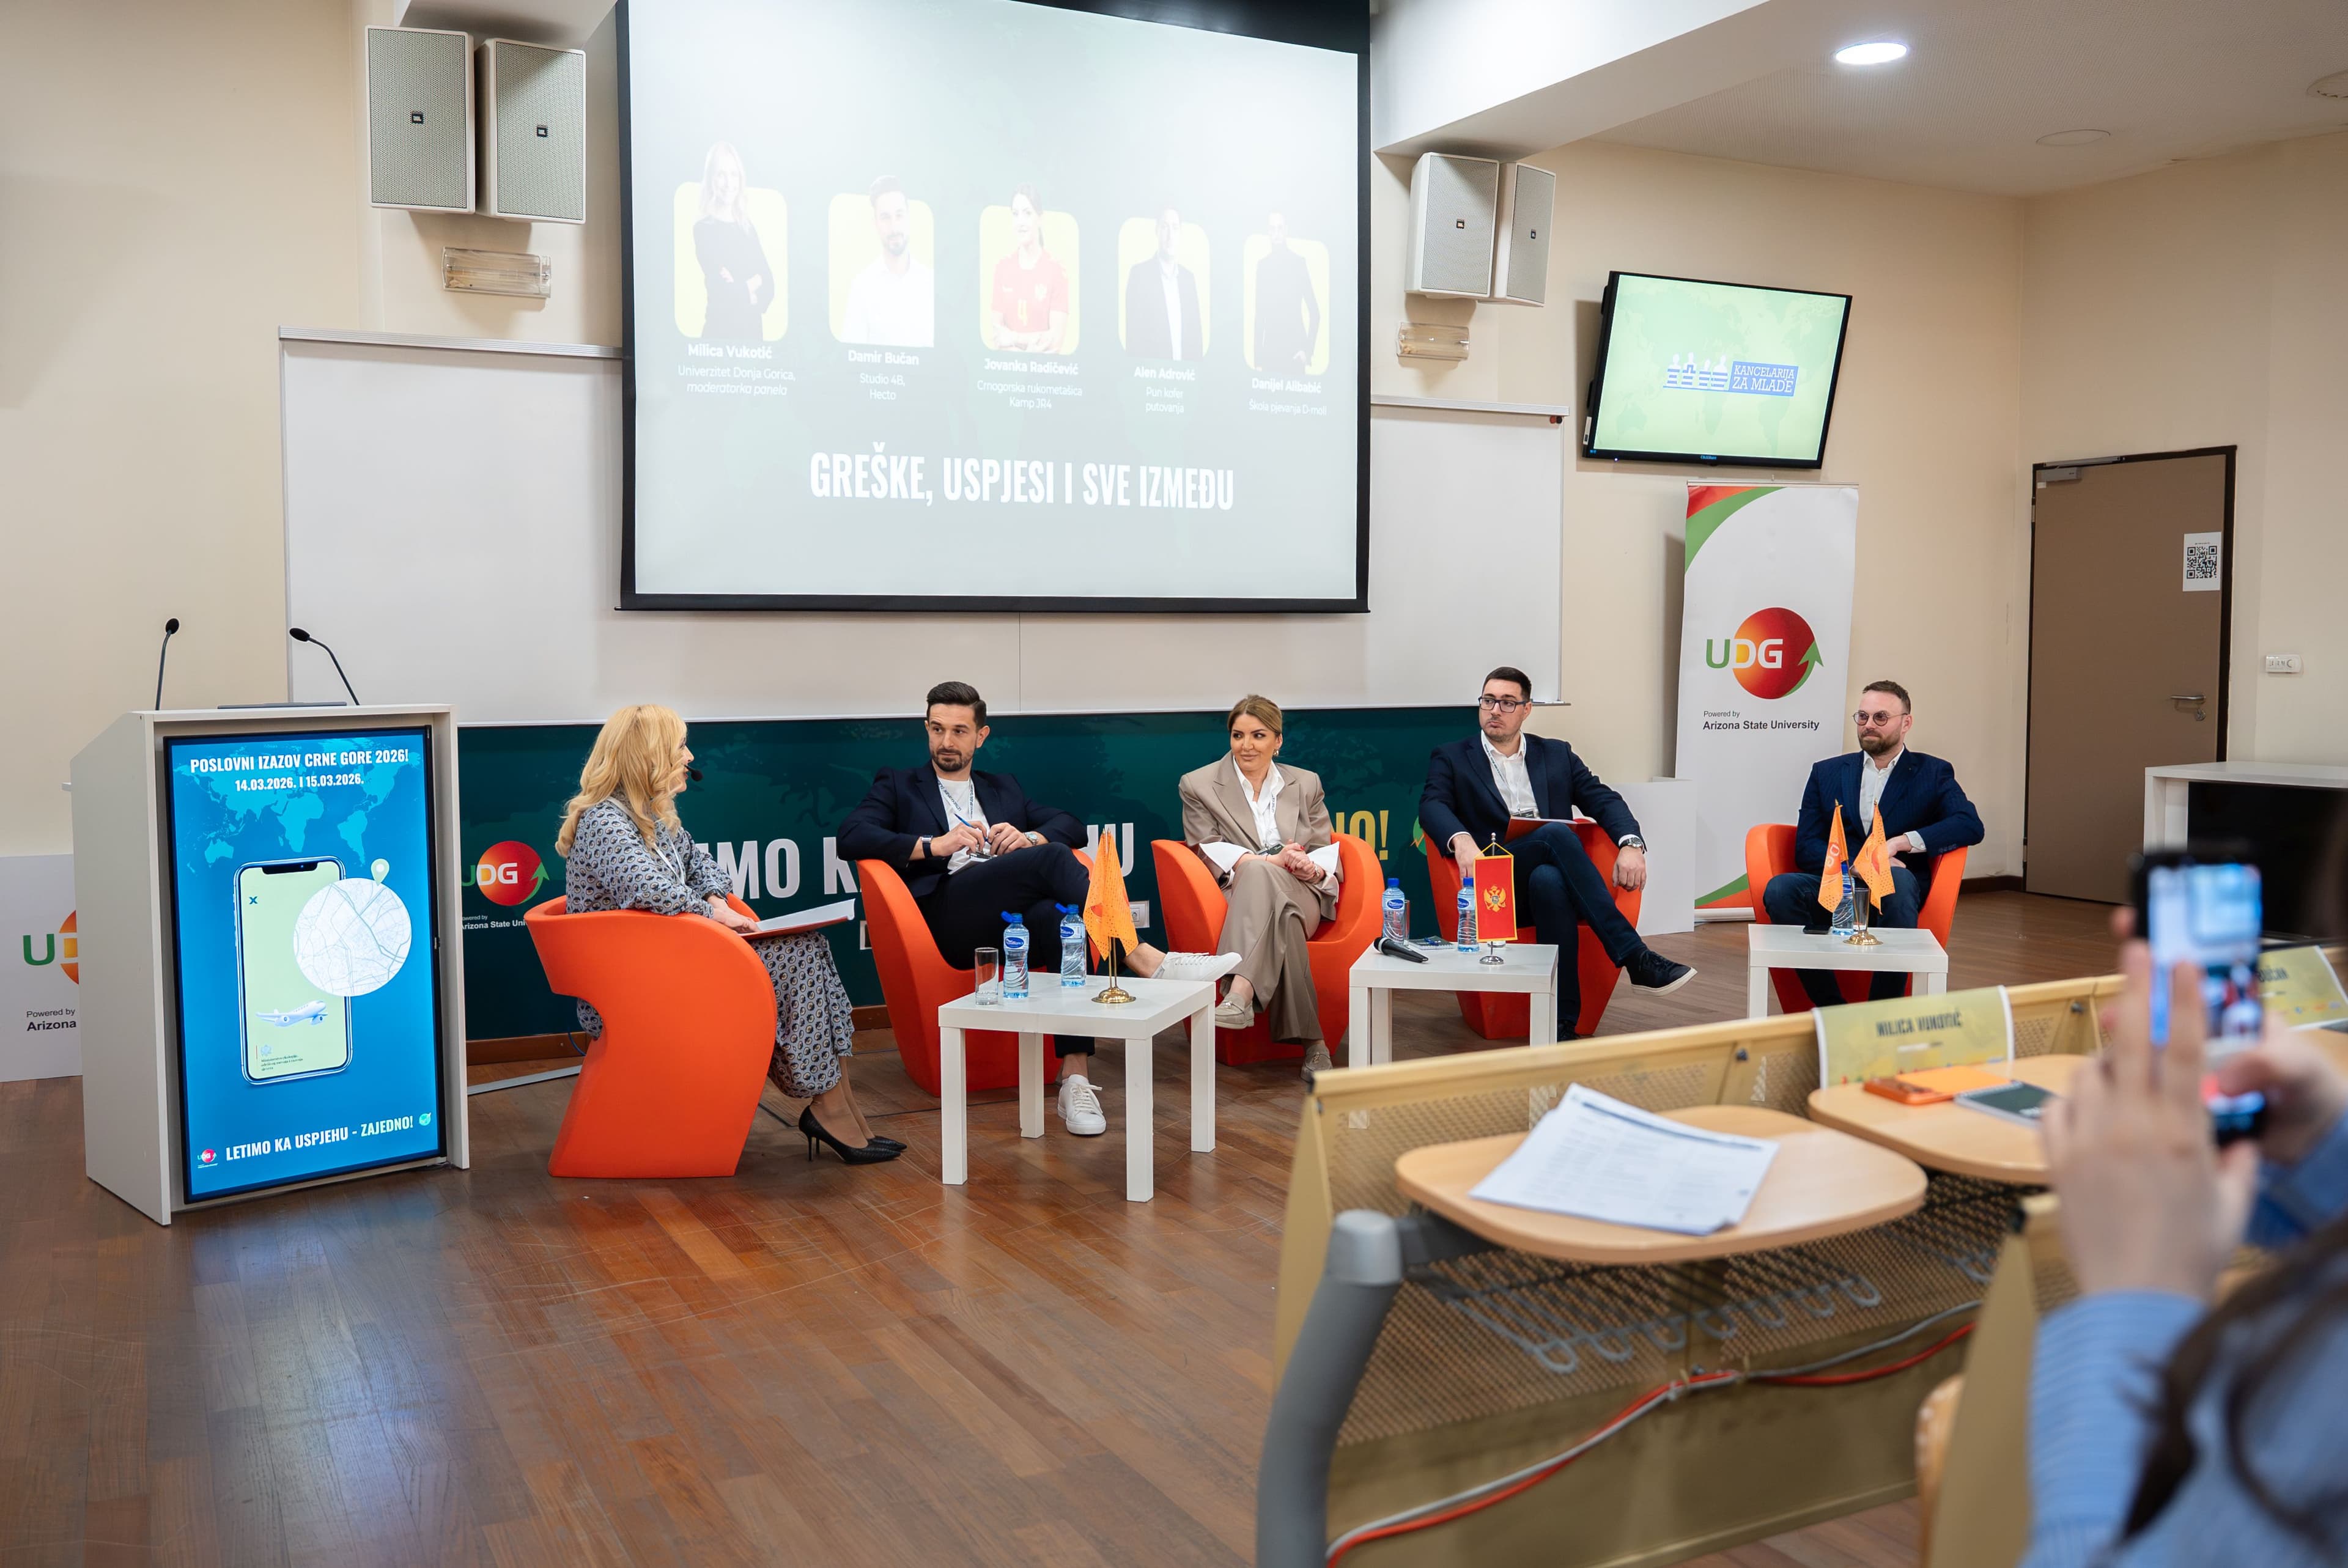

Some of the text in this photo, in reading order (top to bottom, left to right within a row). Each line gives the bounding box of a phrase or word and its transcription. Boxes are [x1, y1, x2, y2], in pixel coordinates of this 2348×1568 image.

[688, 344, 772, 359] Milica Vukotić
[848, 350, 919, 366] Damir Bučan
[678, 364, 796, 383] Univerzitet Donja Gorica,
[984, 358, 1079, 376] Jovanka Radičević
[1134, 366, 1195, 381] Alen Adrović
[1734, 365, 1795, 379] KANCELARIJA
[860, 372, 888, 385] Studio
[1252, 377, 1321, 394] Danijel Alibabić
[1732, 377, 1793, 393] ZA MLADE
[687, 382, 788, 397] moderatorka panela
[869, 389, 896, 401] Hecto
[976, 380, 1083, 397] Crnogorska rukometašica
[1146, 387, 1184, 399] Pun kofer
[1010, 397, 1052, 410] Kamp JR4
[1145, 402, 1184, 415] putovanja
[1249, 399, 1269, 413] Škola
[1271, 401, 1301, 416] pjevanja
[810, 442, 1234, 510] GREŠKE, USPJESI I SVE IZMEĐU
[1706, 638, 1784, 669] UDG
[1703, 720, 1820, 731] Arizona State University
[190, 748, 409, 773] POSLOVNI IZAZOV CRNE GORE 2026!
[235, 773, 364, 792] 14.03.2026. I 15.03.2026.
[695, 839, 800, 899] MO
[26, 1009, 63, 1018] Powered
[26, 1019, 76, 1031] Arizona
[226, 1140, 271, 1161] LETIMO
[275, 1136, 292, 1152] KA
[295, 1127, 349, 1148] USPJEHU
[361, 1116, 414, 1137] ZAJEDNO!
